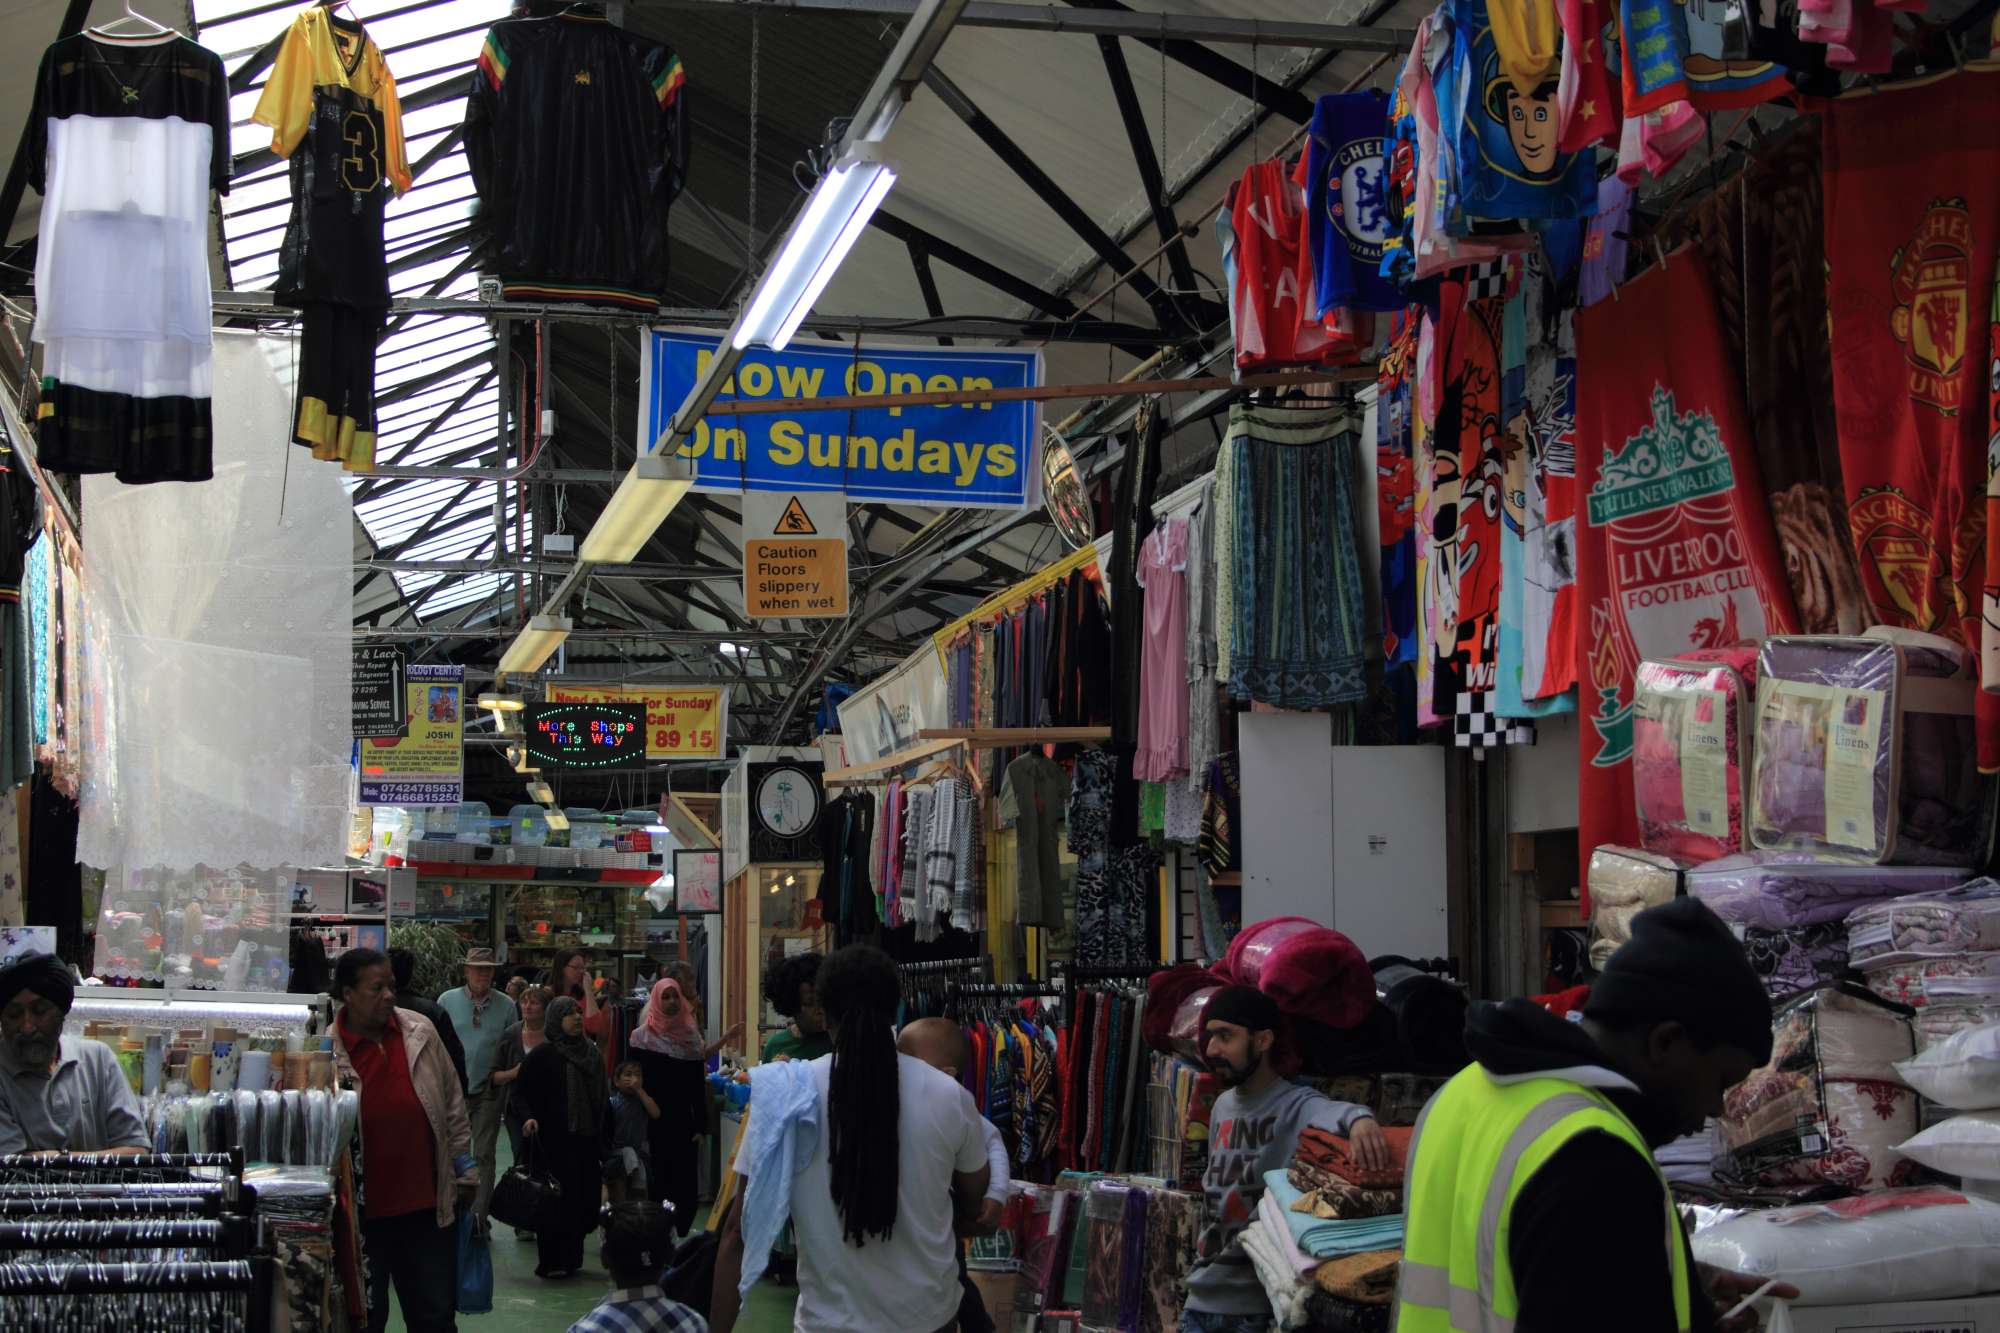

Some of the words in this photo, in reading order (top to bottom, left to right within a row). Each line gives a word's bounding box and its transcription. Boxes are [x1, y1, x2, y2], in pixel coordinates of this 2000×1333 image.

[342, 110, 380, 192] 3
[845, 361, 993, 417] Open
[768, 420, 1016, 487] Sundays
[758, 546, 817, 559] Caution
[1617, 527, 1744, 585] LIVERPOO
[758, 563, 806, 575] Floors
[759, 580, 820, 594] slippery
[1713, 568, 1751, 593] CLU
[760, 597, 799, 609] when
[807, 596, 835, 608] wet
[373, 649, 397, 659] Lace
[665, 696, 712, 712] Sunday
[647, 713, 675, 725] Call
[538, 720, 575, 732] More
[591, 720, 634, 734] Shops
[425, 731, 454, 739] JOSHI
[549, 732, 582, 744] This
[591, 732, 624, 746] Way
[656, 730, 681, 748] 89
[689, 730, 713, 748] 15
